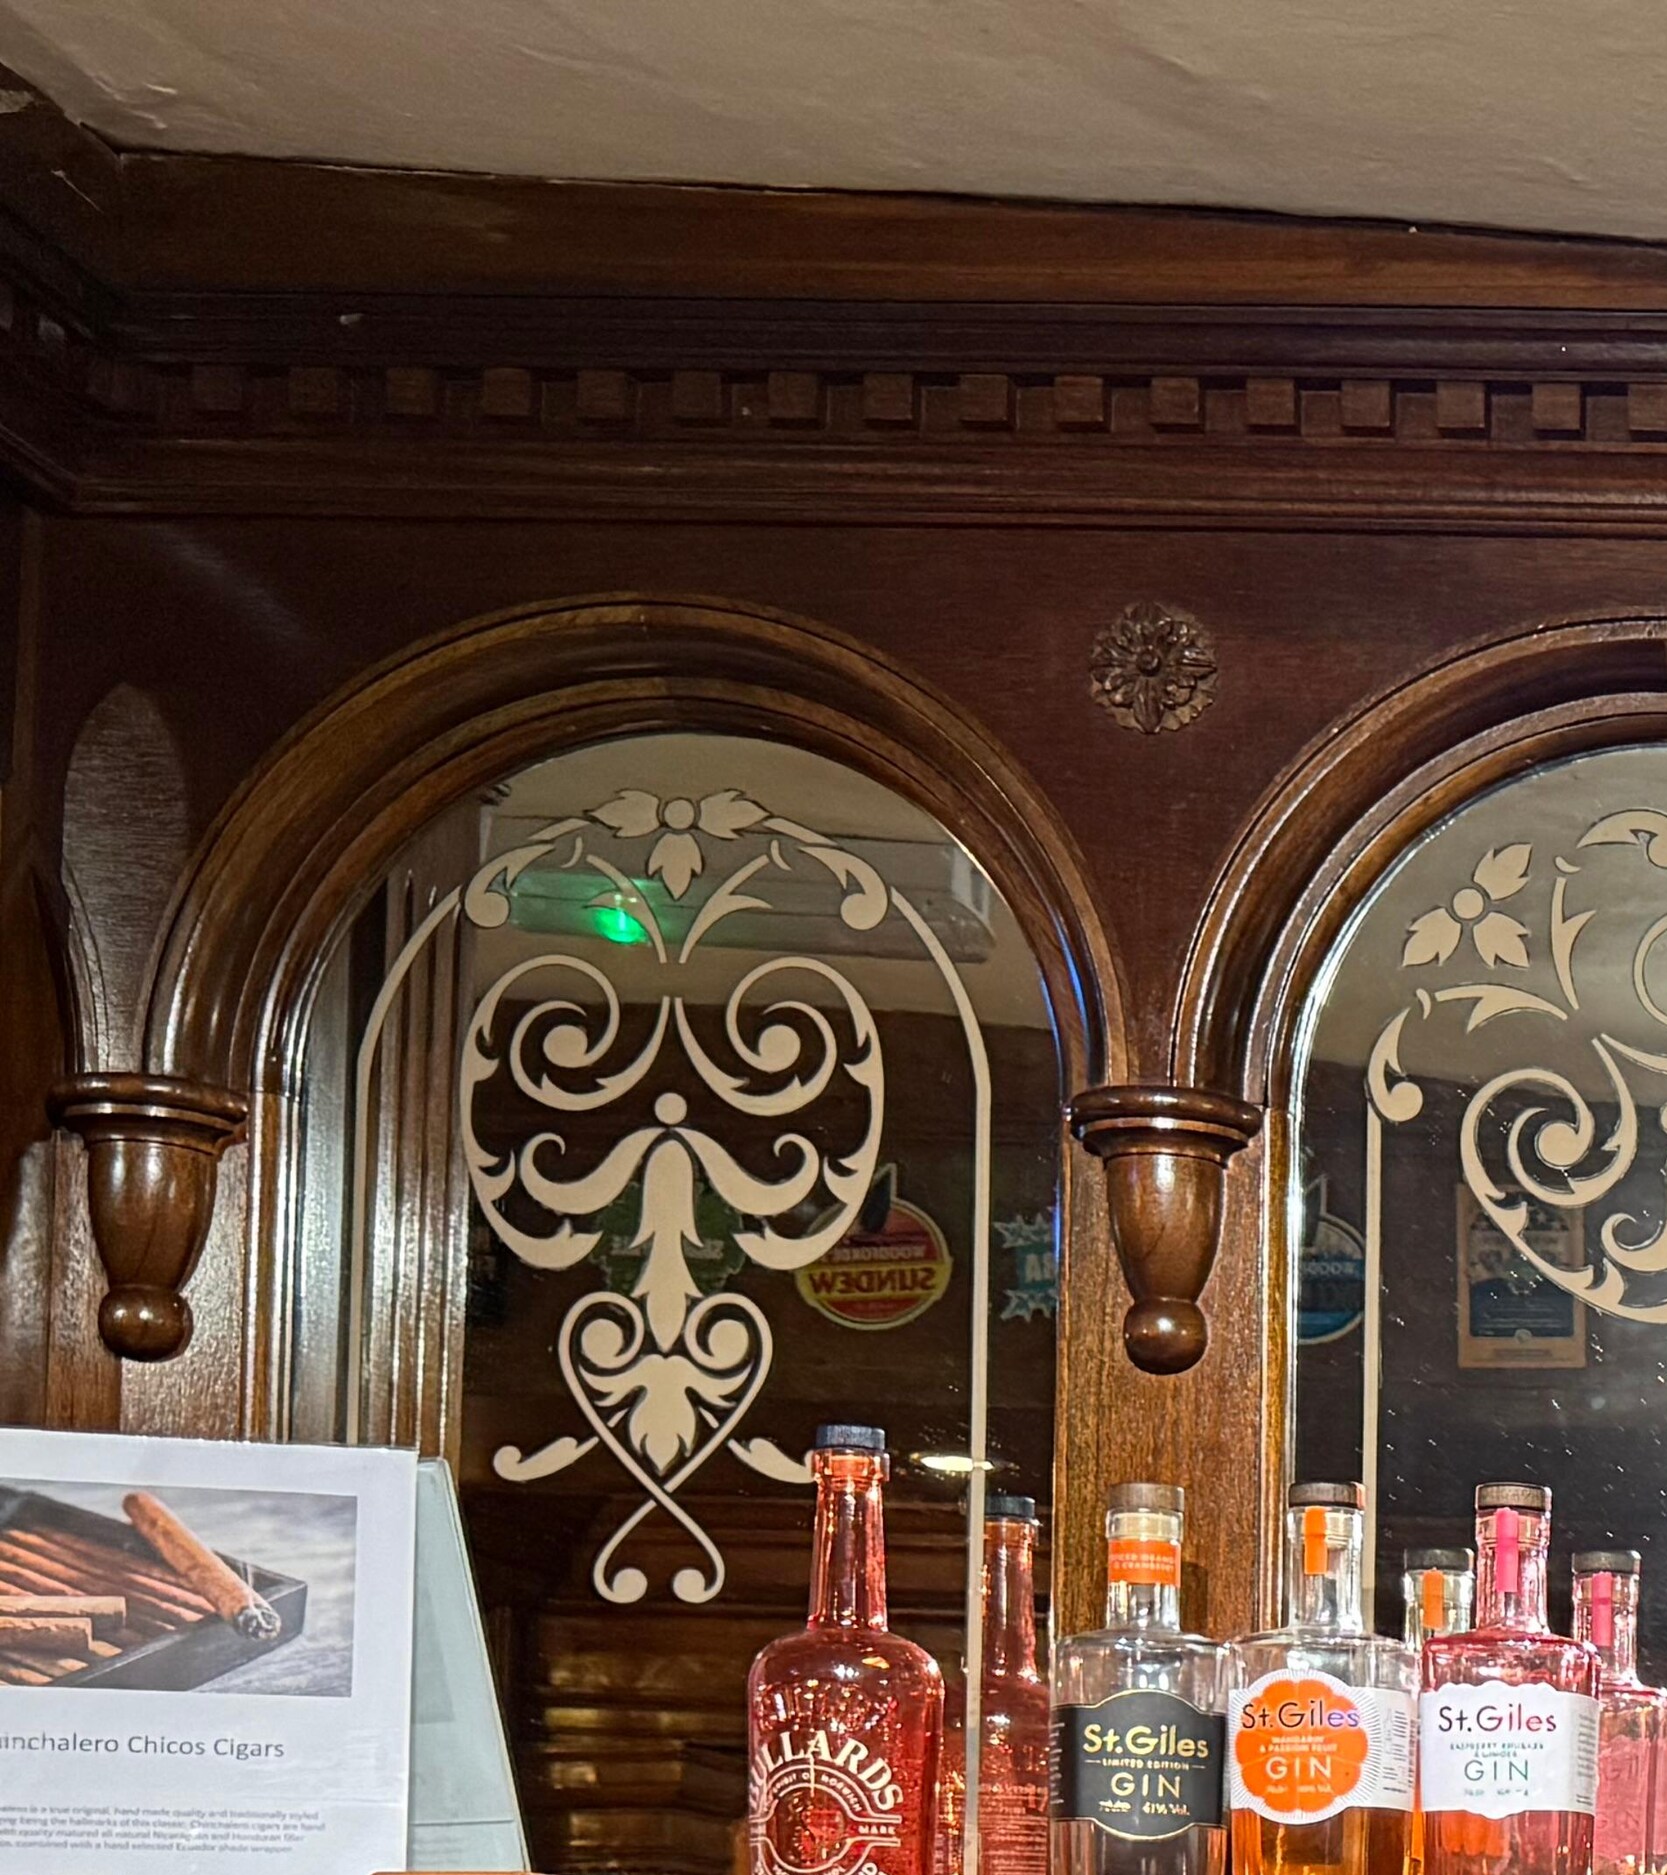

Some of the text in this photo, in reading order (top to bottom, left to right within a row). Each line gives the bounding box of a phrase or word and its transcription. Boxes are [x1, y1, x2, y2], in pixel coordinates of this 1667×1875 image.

[1242, 1700, 1360, 1728] St.Giles
[1438, 1703, 1557, 1732] St.Giles
[128, 1735, 206, 1756] Chicos
[214, 1737, 285, 1760] Cigars
[1083, 1724, 1208, 1758] St.Giles
[1266, 1756, 1331, 1779] GIN
[1464, 1760, 1528, 1781] GIN
[1111, 1772, 1180, 1799] GIN
